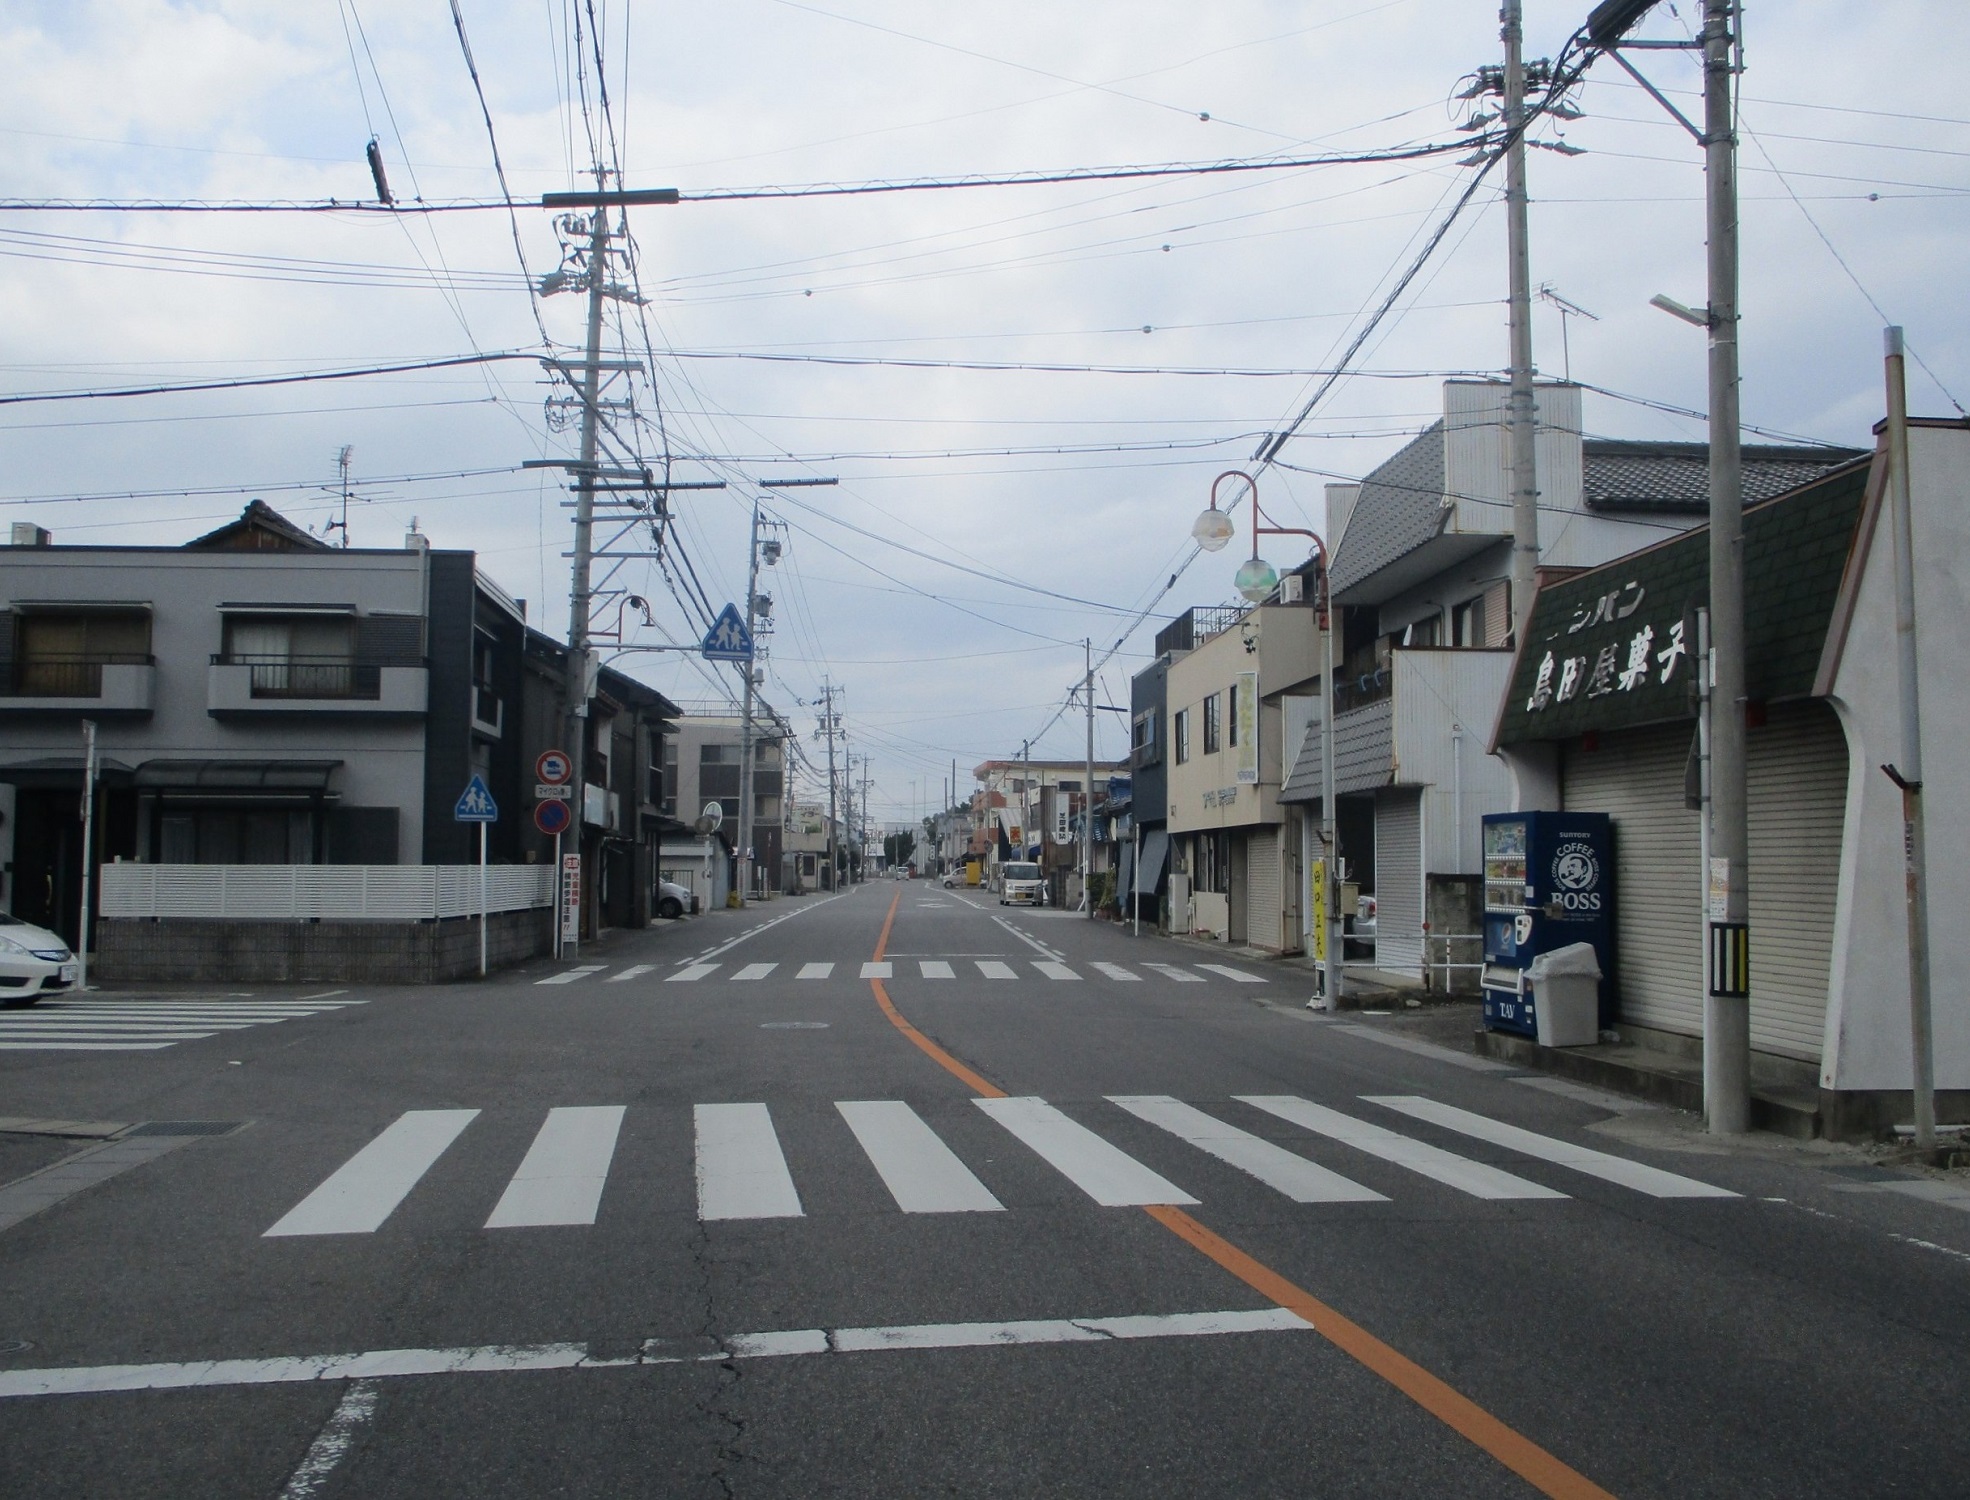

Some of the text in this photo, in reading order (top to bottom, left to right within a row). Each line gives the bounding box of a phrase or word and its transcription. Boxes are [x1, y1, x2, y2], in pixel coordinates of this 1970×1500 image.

[1559, 831, 1592, 839] SUNTORY
[1556, 842, 1595, 858] COFFEE
[1551, 892, 1601, 910] BOSS
